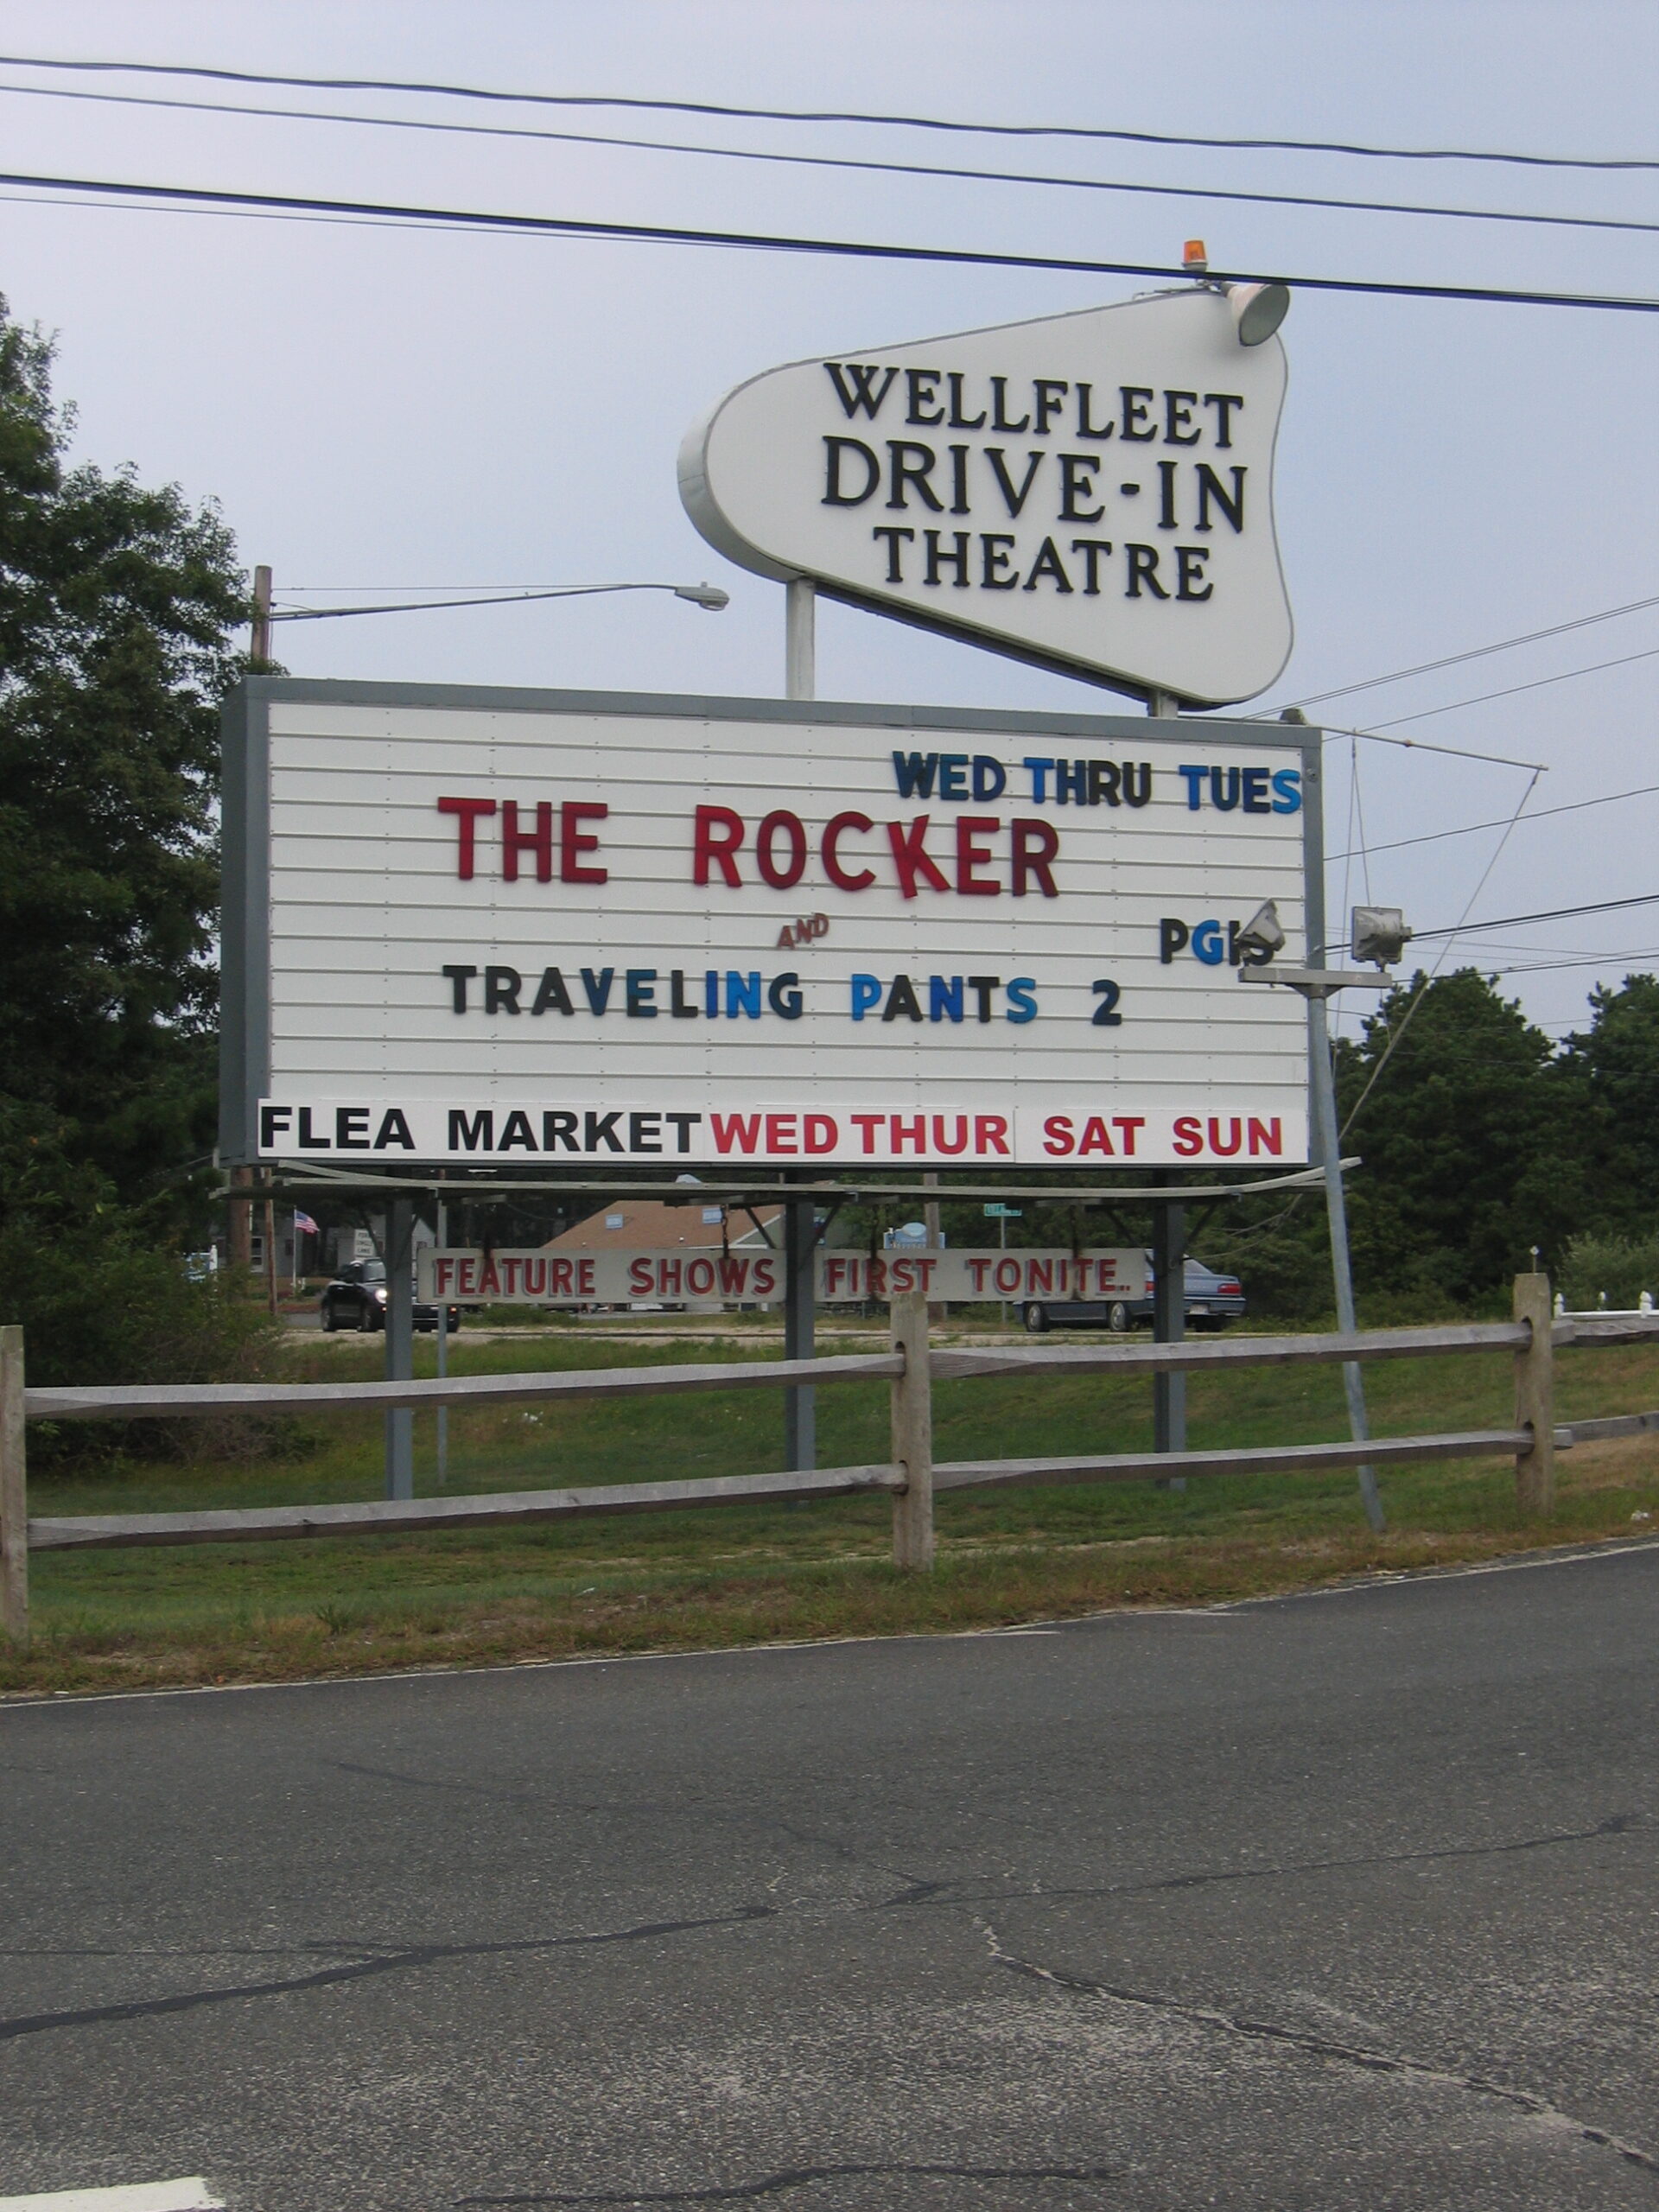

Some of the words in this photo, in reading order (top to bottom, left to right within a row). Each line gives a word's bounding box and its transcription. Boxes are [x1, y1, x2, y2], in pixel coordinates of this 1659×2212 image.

[823, 362, 1243, 448] WELLFLEET
[821, 435, 1248, 533] DRIVE-IN
[873, 526, 1214, 601] THEATRE
[893, 751, 1007, 802] WED
[1024, 757, 1152, 807] THRU
[1179, 764, 1302, 814] TUES
[437, 797, 608, 884] THE
[693, 804, 1059, 899] ROCKER
[776, 912, 830, 950] AND
[442, 965, 804, 1020] TRAVELING
[851, 973, 1038, 1024] PANTS
[1092, 979, 1122, 1026] 2
[260, 1106, 416, 1150] FLEA
[448, 1109, 702, 1154] MARKET
[710, 1113, 839, 1154] WED
[851, 1115, 1010, 1154] THUR
[1042, 1116, 1146, 1156] SAT
[1172, 1116, 1282, 1156] SUN
[435, 1257, 596, 1295] FEATURE
[628, 1257, 776, 1295] SHOWS
[825, 1257, 938, 1294] FIRST
